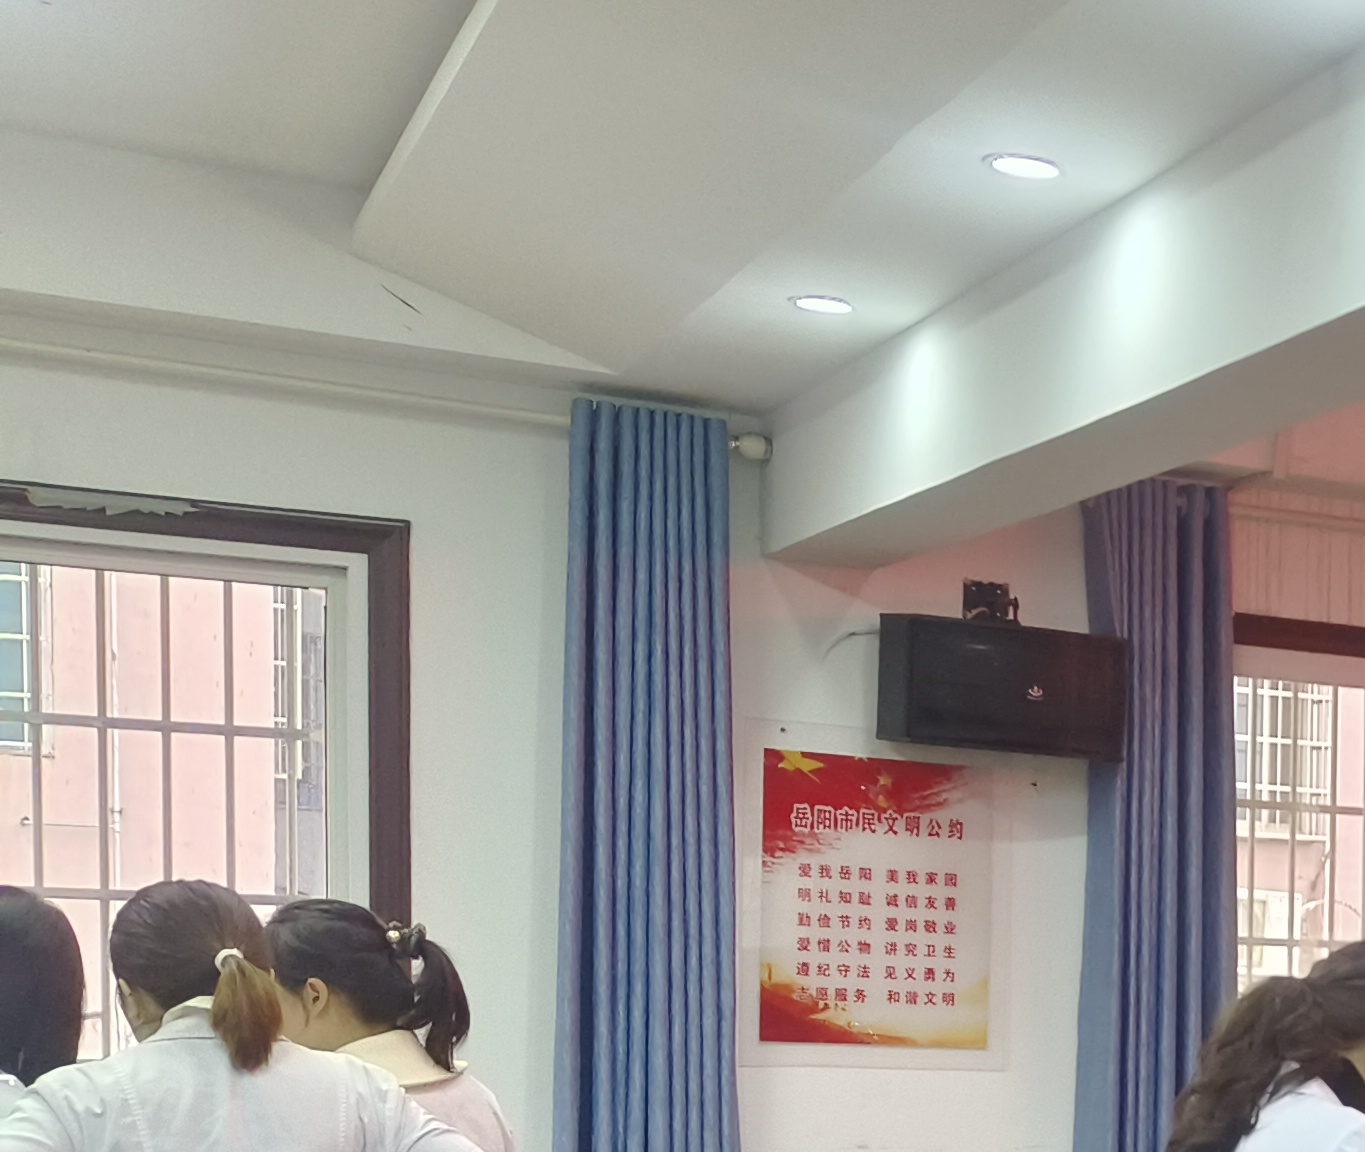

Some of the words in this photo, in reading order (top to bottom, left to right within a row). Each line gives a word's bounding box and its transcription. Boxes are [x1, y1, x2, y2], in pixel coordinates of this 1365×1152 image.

[793, 805, 964, 841] 岳阳市民文明公约
[798, 863, 872, 881] 爱我岳阳
[886, 868, 958, 888] 美我家园
[797, 887, 872, 906] 明礼知耻
[885, 893, 957, 911] 诚信友善
[797, 912, 872, 931] 勤俭节约
[884, 917, 957, 935] 爱岗敬业
[796, 937, 872, 955] 爱惜公物
[884, 941, 957, 959] 讲究卫生
[795, 961, 871, 979] 遵纪守法
[883, 965, 955, 983] 见义勇为
[795, 986, 867, 1004] 志愿服务
[887, 989, 955, 1007] 和谐文明
